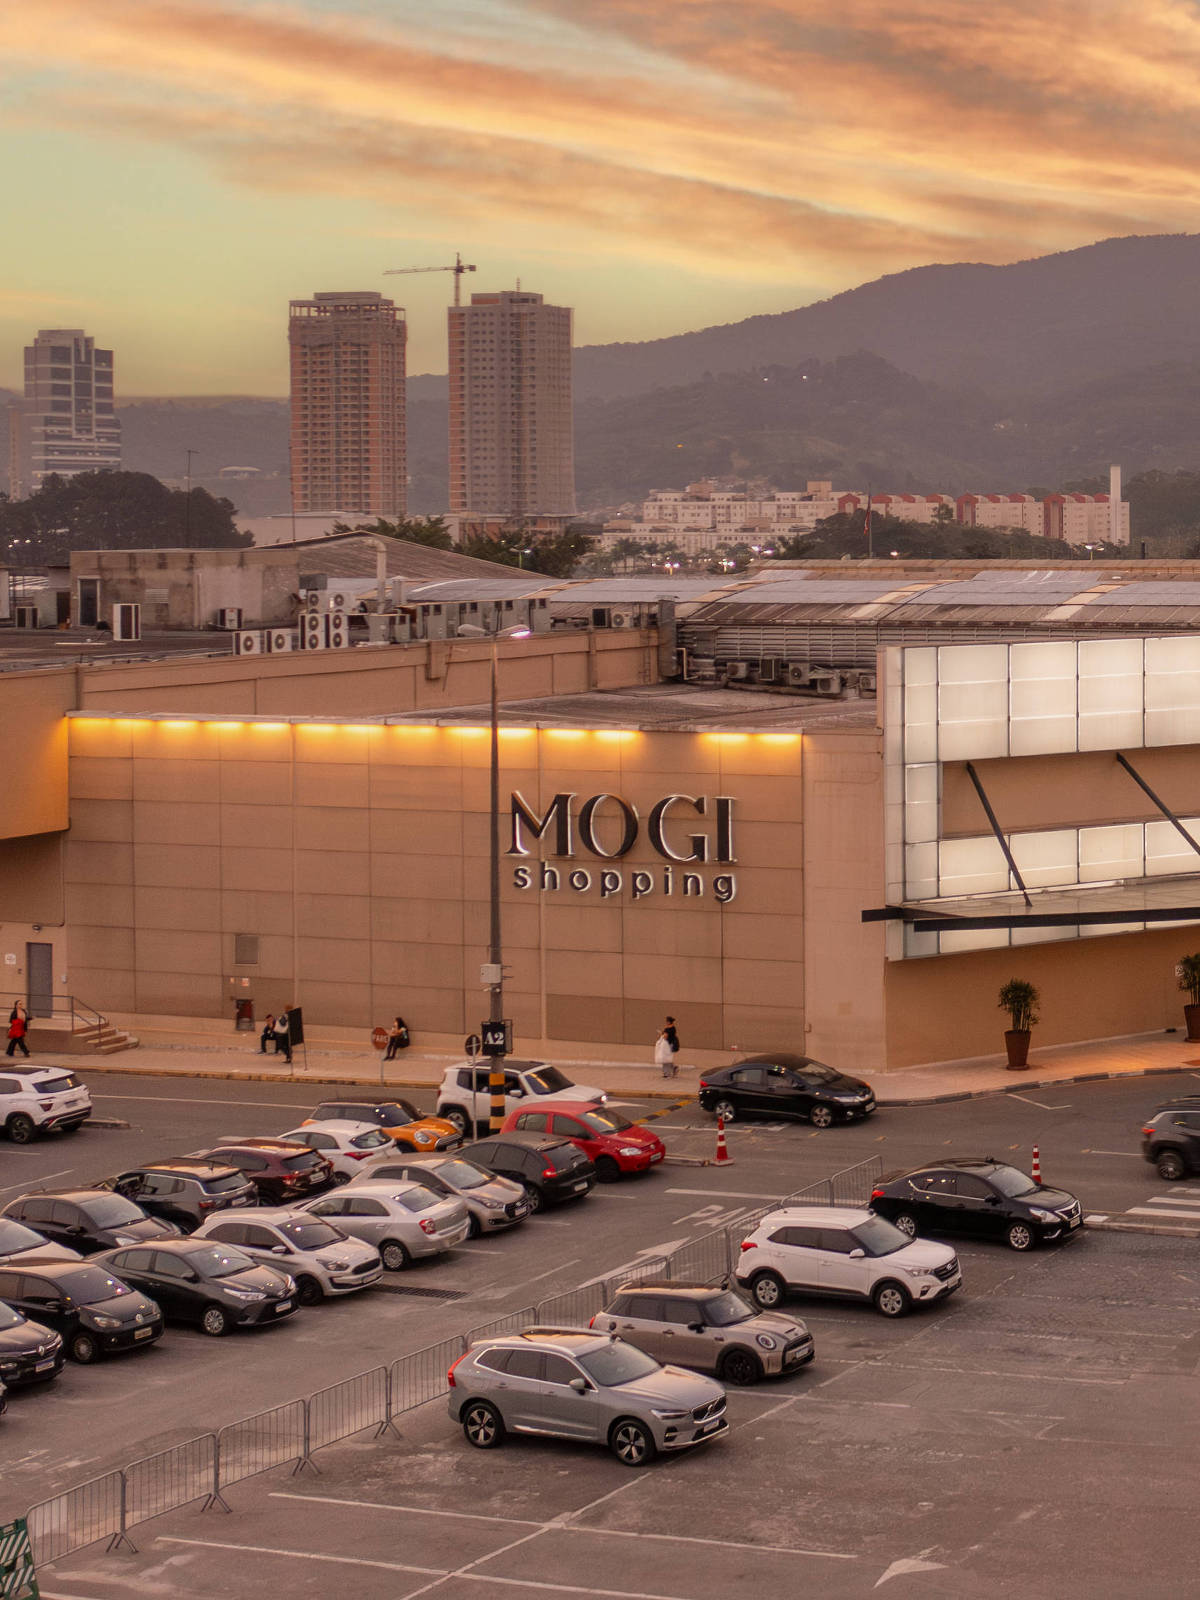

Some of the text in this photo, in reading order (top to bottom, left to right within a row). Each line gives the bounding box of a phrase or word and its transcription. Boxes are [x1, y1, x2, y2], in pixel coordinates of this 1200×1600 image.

[504, 790, 738, 863] MOGI
[513, 860, 738, 904] shopping
[484, 1031, 505, 1045] A2
